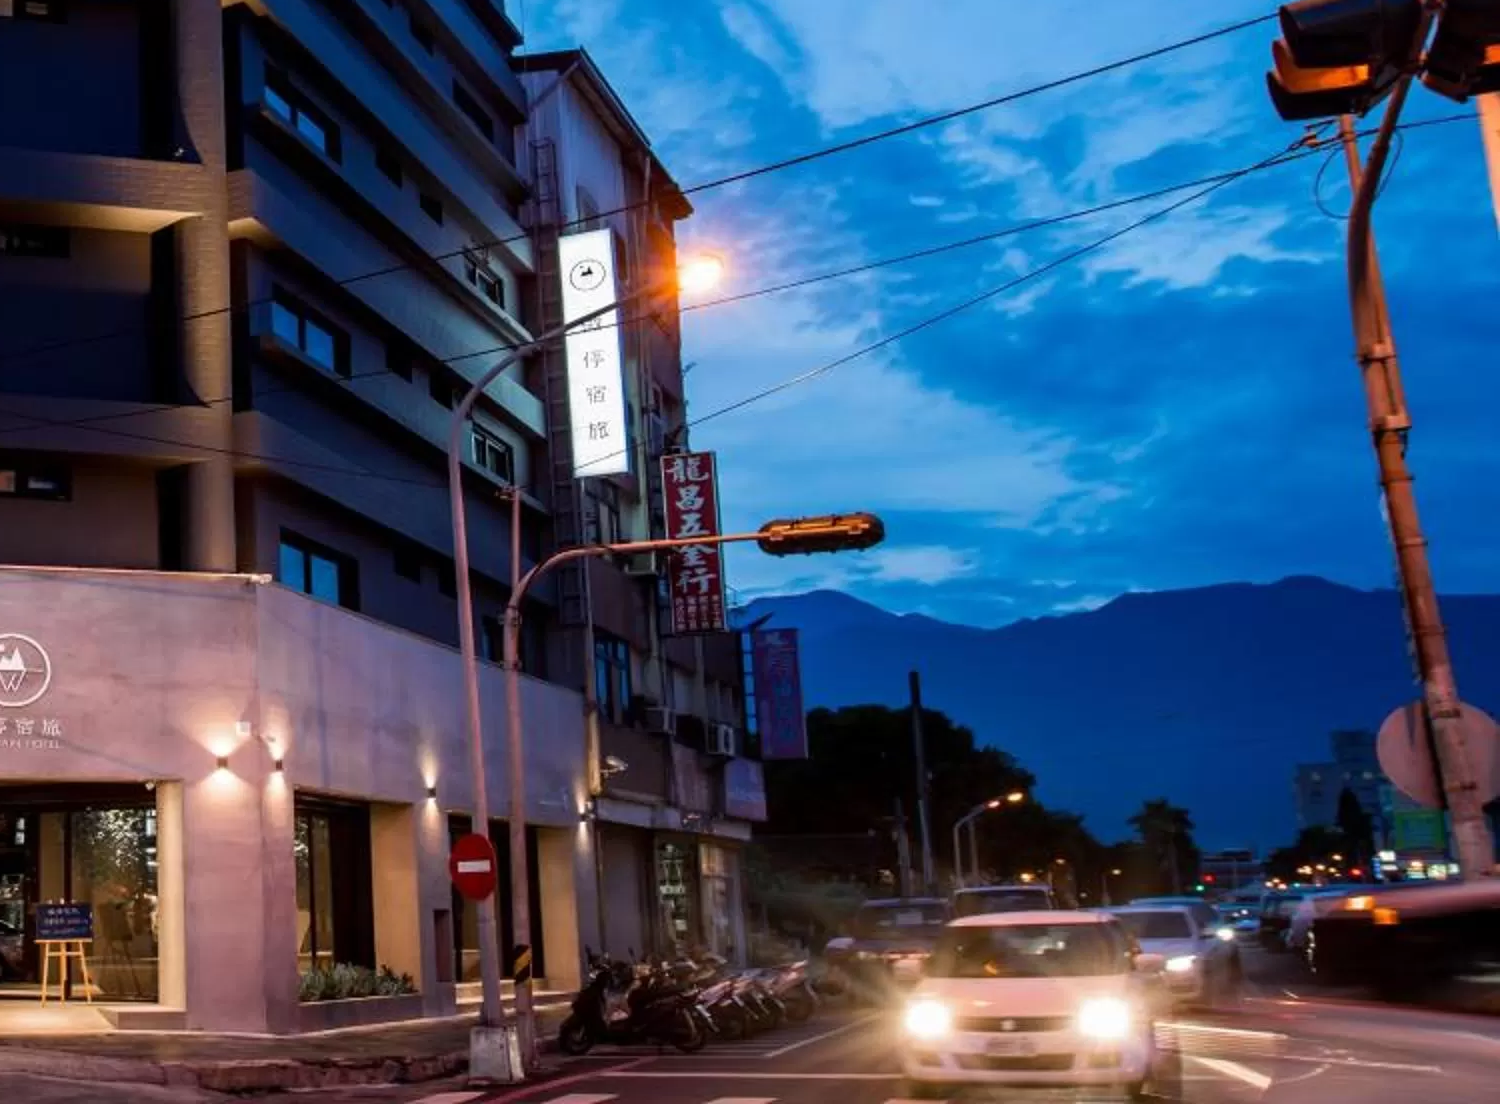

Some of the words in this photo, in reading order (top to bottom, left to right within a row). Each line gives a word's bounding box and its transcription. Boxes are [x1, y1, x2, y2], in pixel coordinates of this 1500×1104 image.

[666, 457, 717, 594] 龍昌五金行
